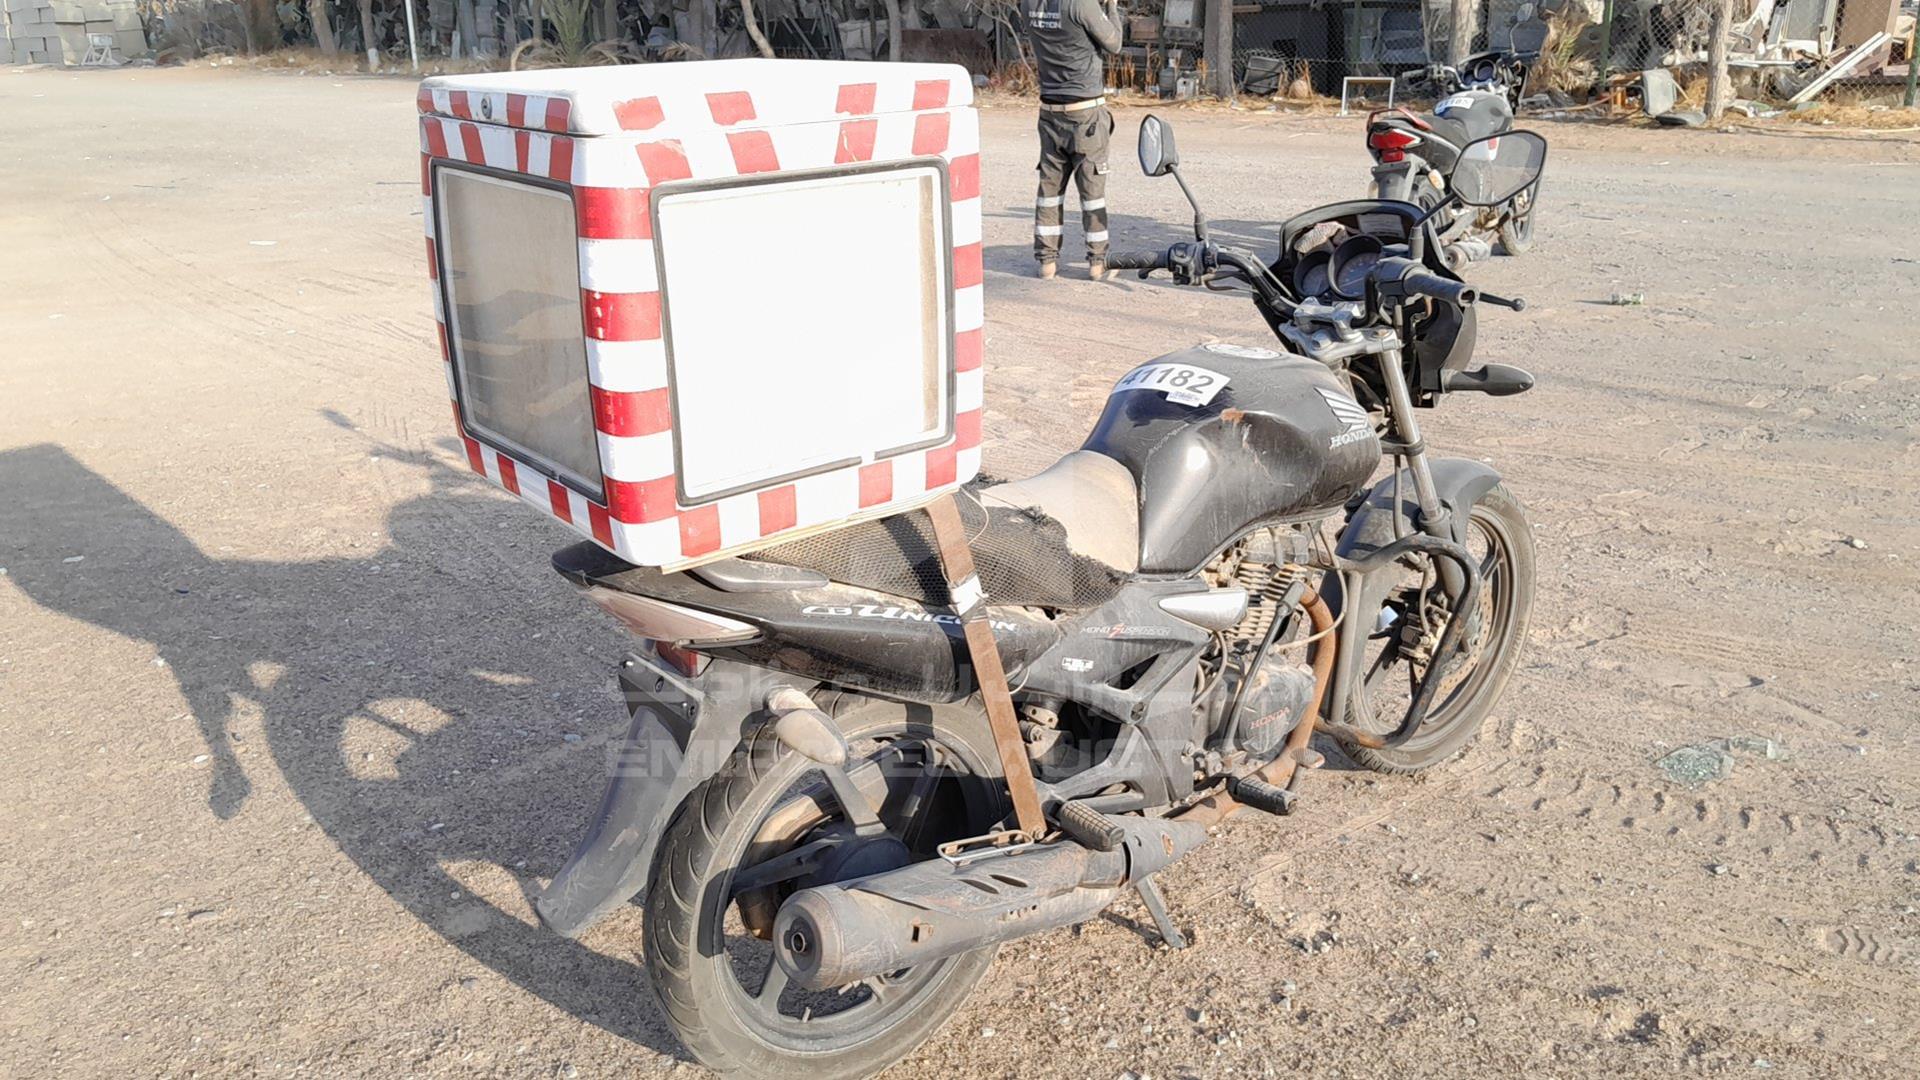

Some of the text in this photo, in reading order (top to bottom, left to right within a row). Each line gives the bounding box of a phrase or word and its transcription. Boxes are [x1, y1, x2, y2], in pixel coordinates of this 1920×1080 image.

[1029, 20, 1062, 29] AUCTION
[1121, 367, 1215, 394] 41182
[1329, 428, 1374, 450] HONDA
[802, 605, 1018, 632] CB UNICN
[1250, 706, 1290, 730] HONDA
